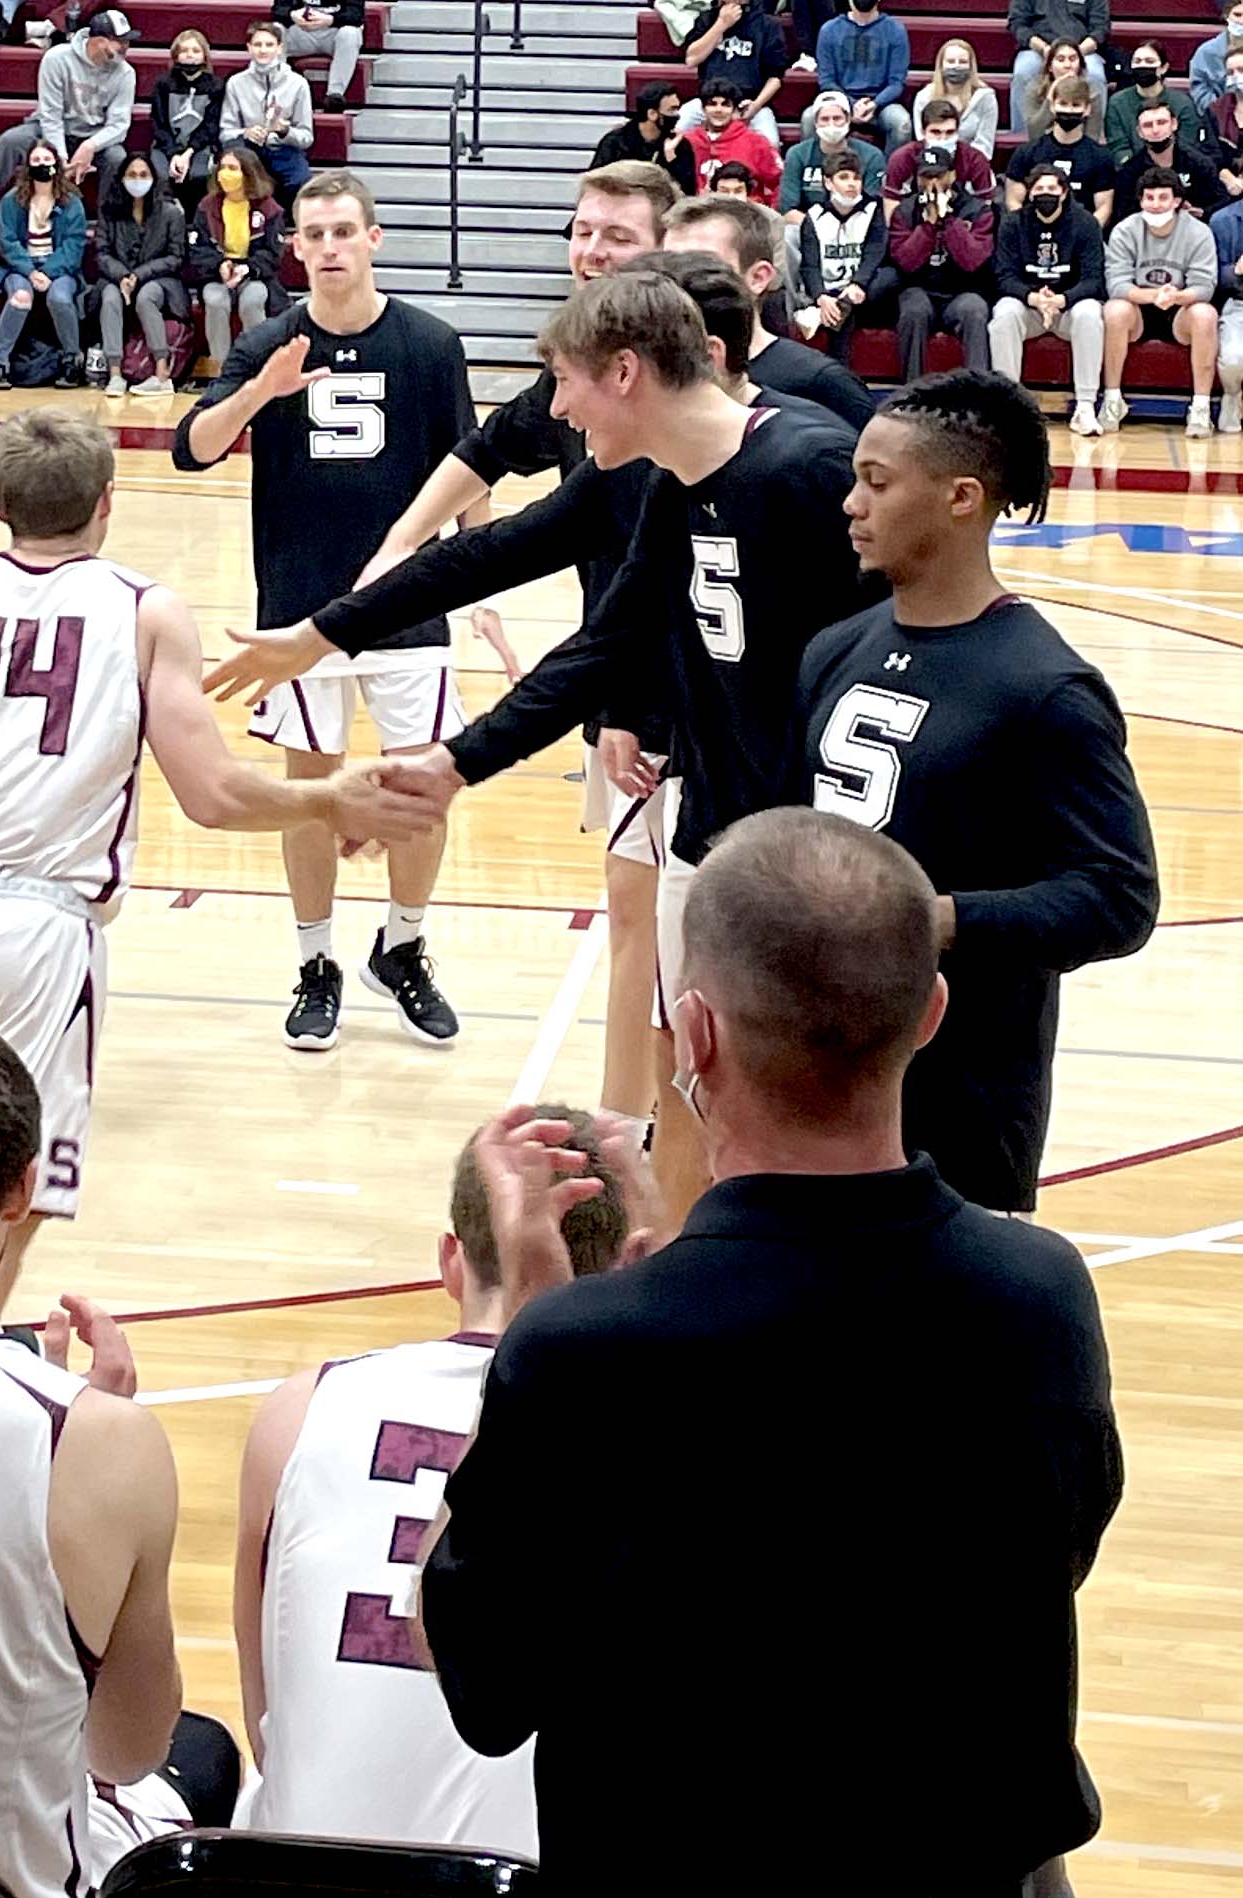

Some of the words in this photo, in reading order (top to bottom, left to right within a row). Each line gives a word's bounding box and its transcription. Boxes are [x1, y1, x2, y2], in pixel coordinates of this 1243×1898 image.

[308, 372, 386, 459] S
[813, 683, 930, 832] S
[45, 1136, 79, 1190] S
